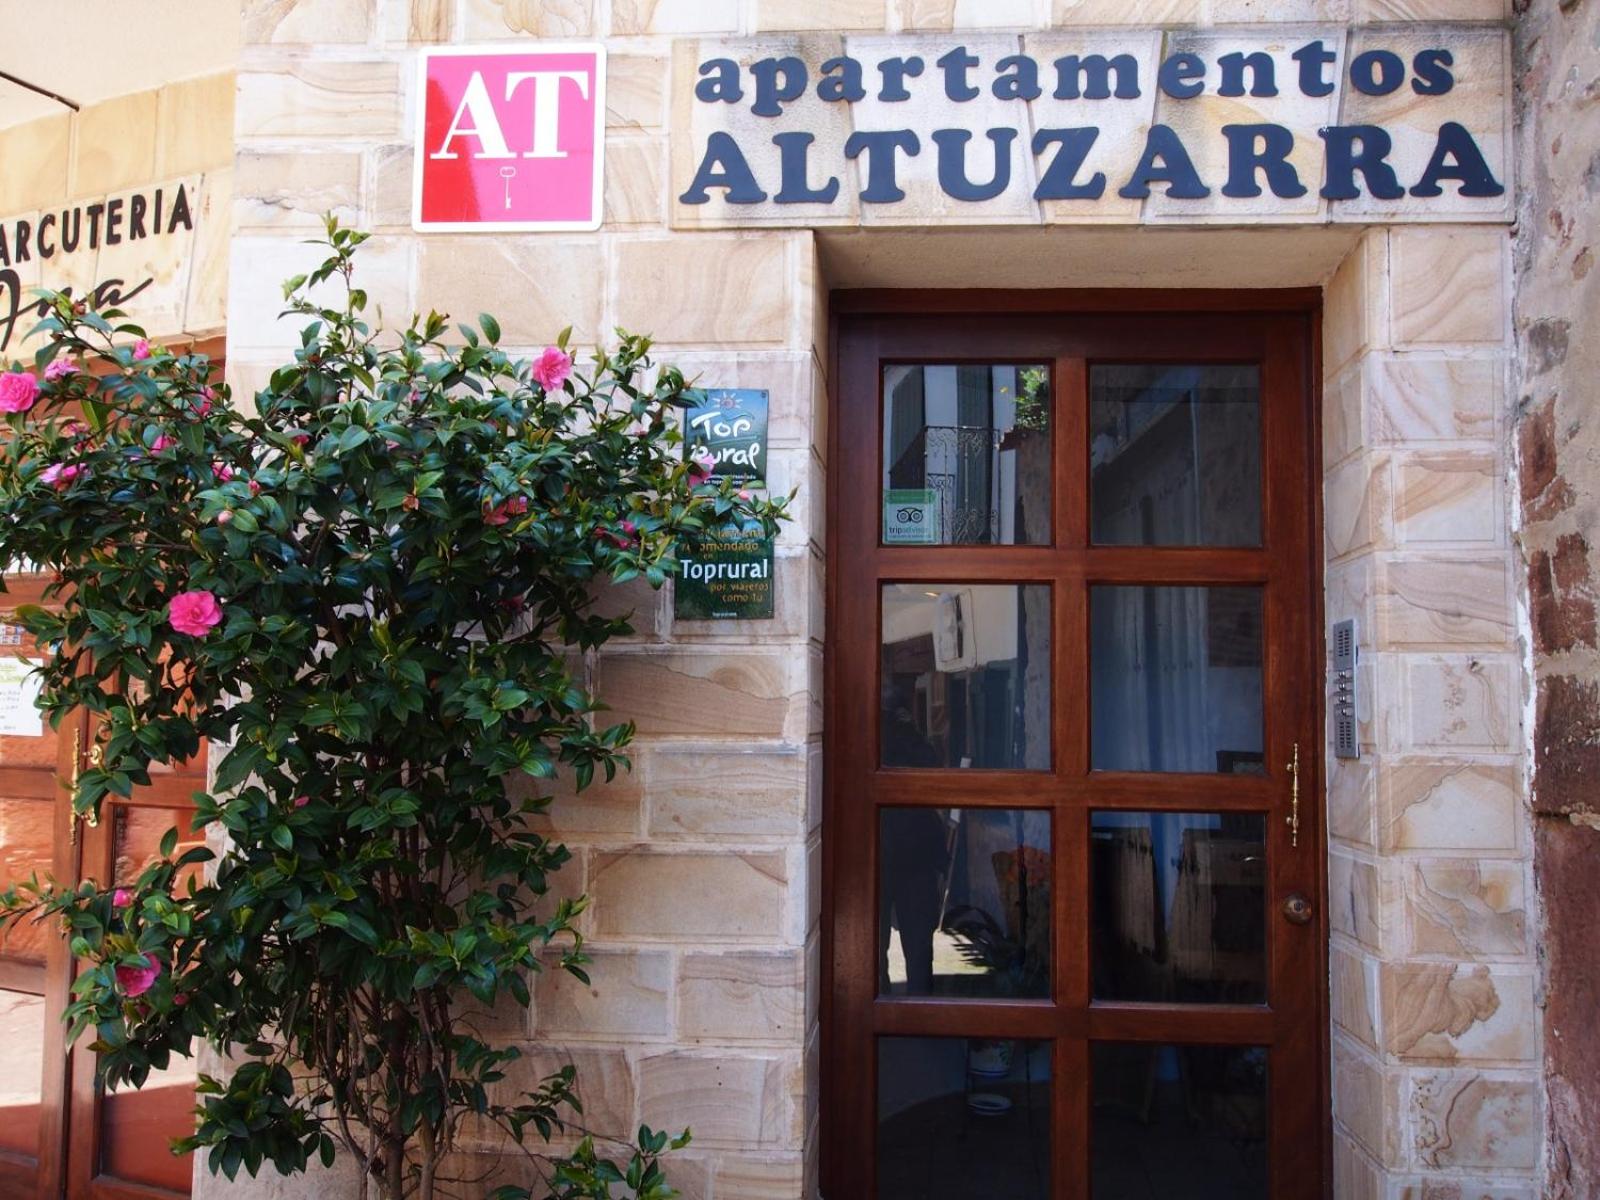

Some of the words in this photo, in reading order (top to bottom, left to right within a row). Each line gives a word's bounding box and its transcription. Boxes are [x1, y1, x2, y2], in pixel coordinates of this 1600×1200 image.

[694, 40, 1455, 118] apartamentos
[429, 70, 590, 160] AT
[679, 121, 1505, 205] ALTUZARRA
[691, 411, 751, 440] Top
[680, 558, 768, 584] Toprural
[721, 593, 749, 602] como
